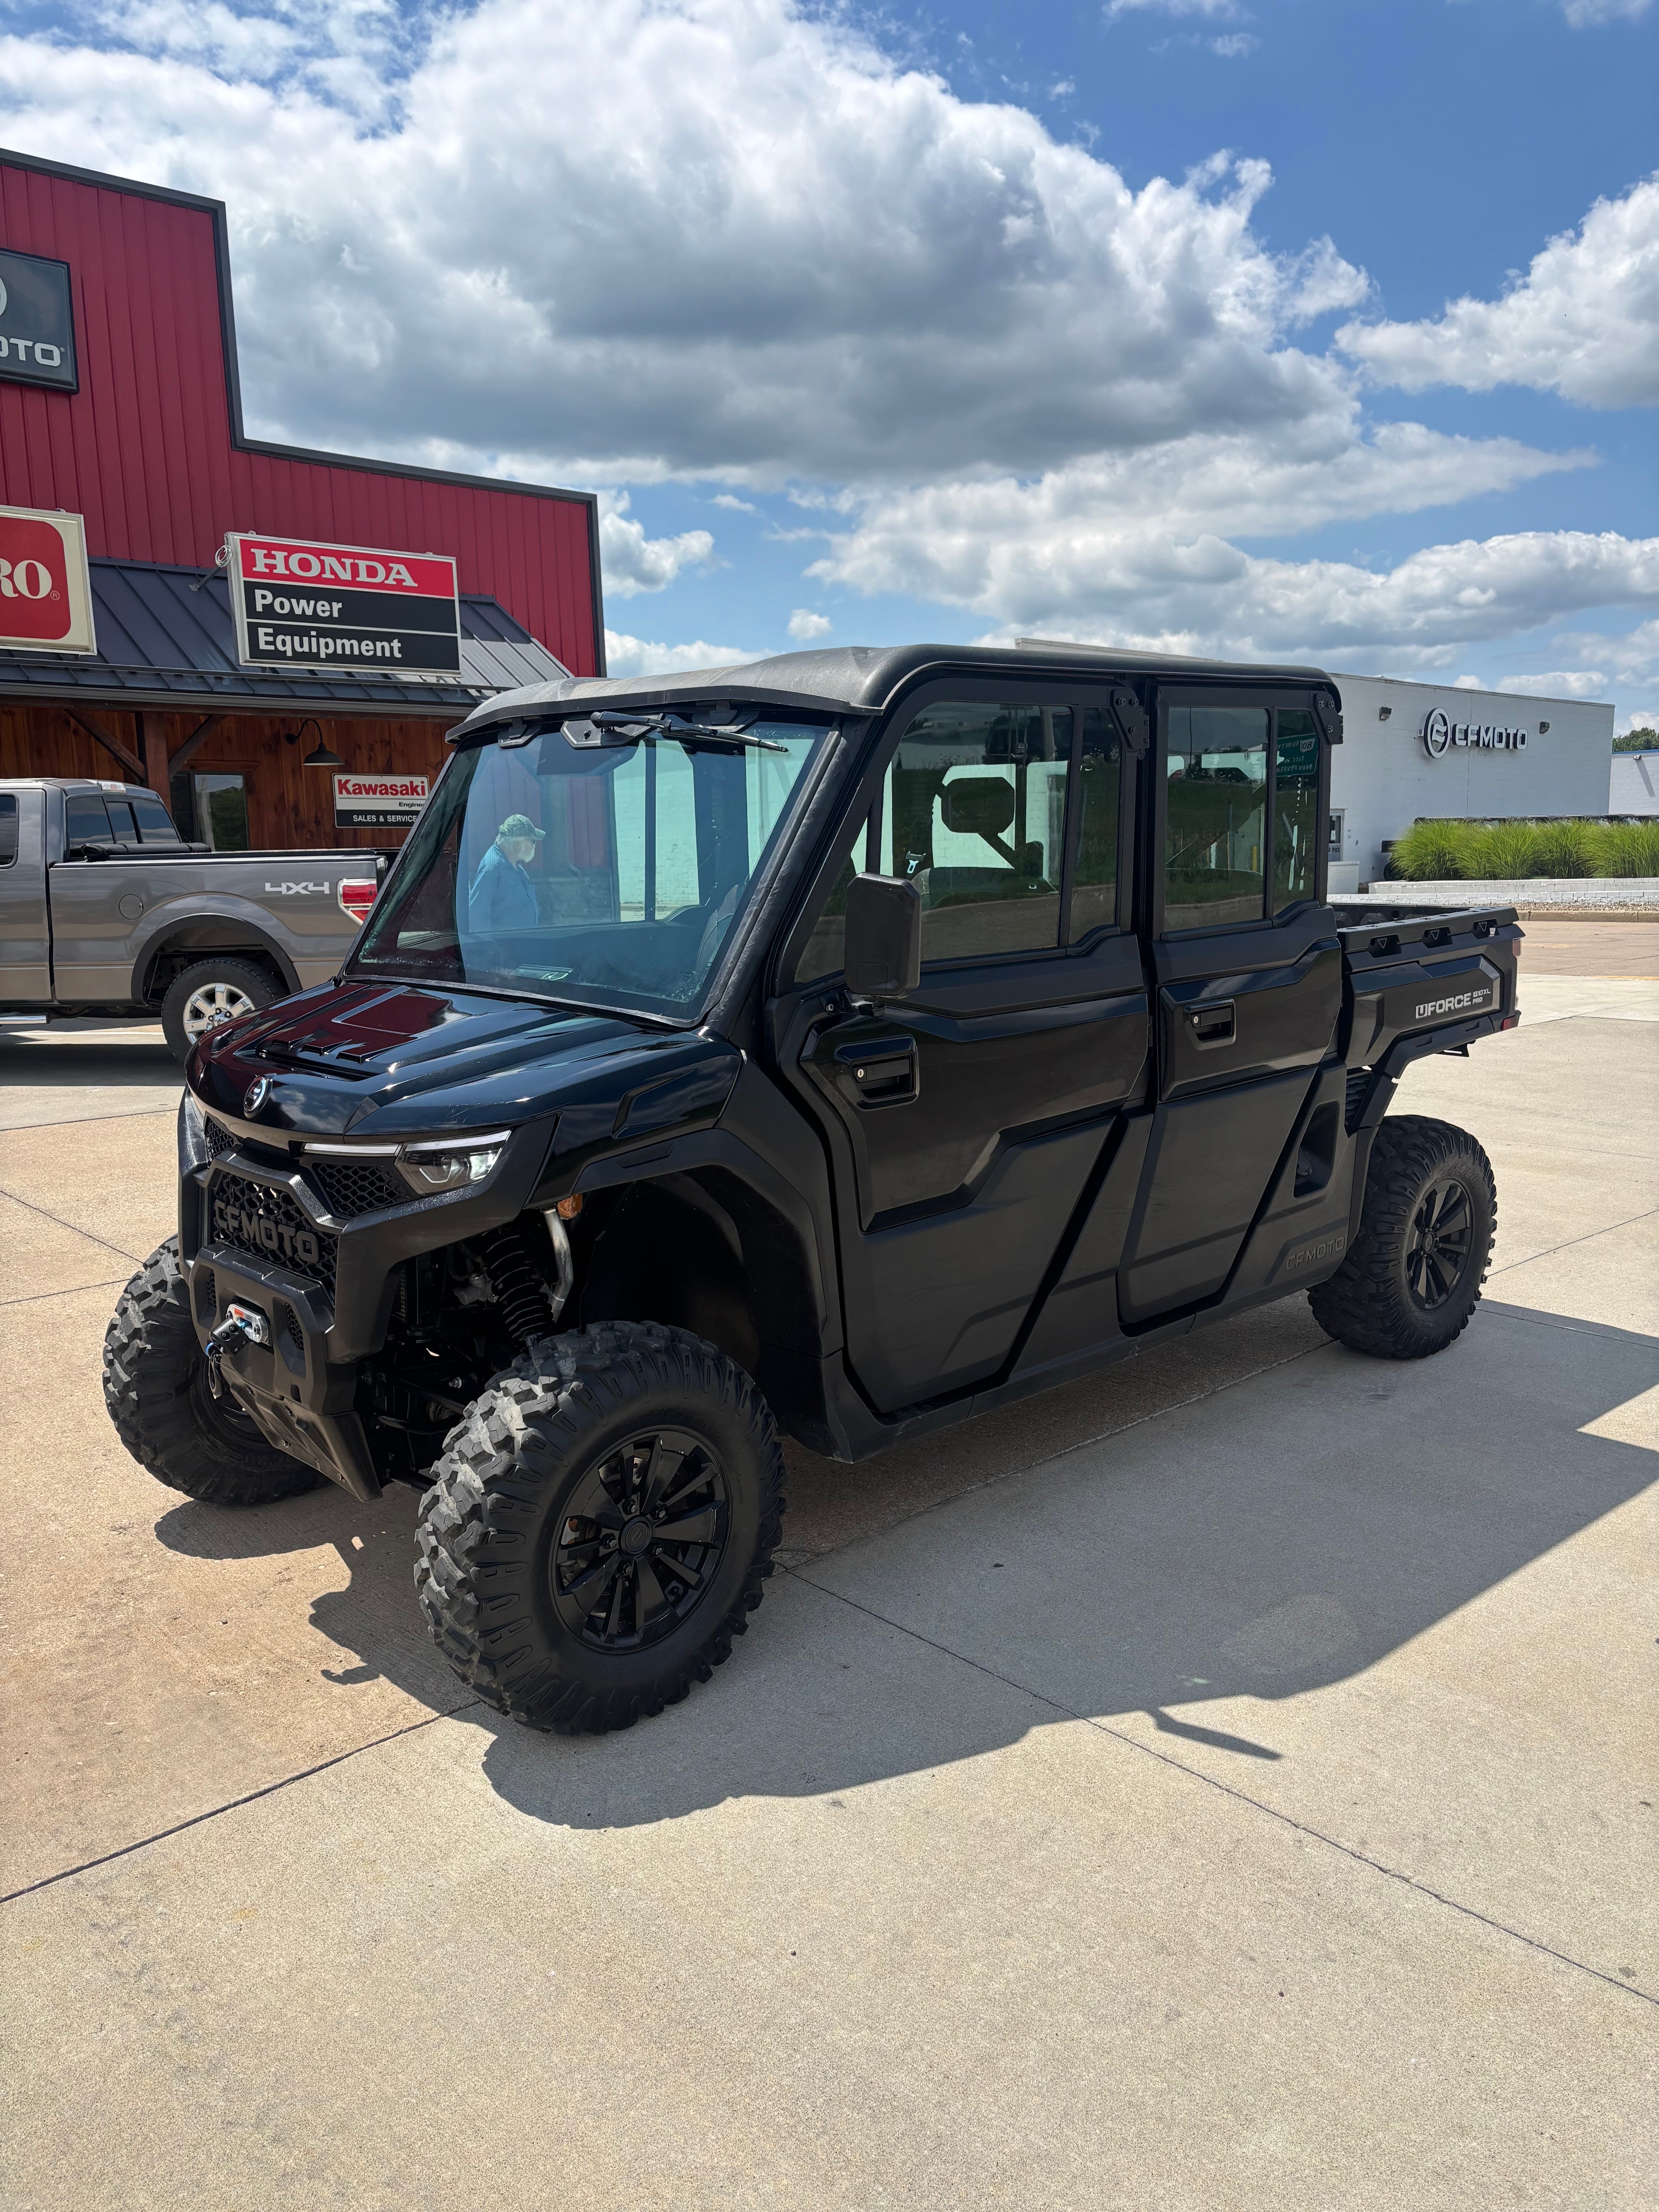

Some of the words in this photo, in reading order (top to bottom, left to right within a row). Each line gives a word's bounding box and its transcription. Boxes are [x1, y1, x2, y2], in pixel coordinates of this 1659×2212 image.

[251, 548, 418, 587] HONDA
[254, 589, 342, 618] Power
[258, 627, 402, 658] Equipment
[1453, 723, 1528, 750] CFMOTO
[337, 779, 426, 796] Kawasaki
[214, 1199, 319, 1264] CFMOTO
[1286, 1236, 1345, 1270] CFMOTO
